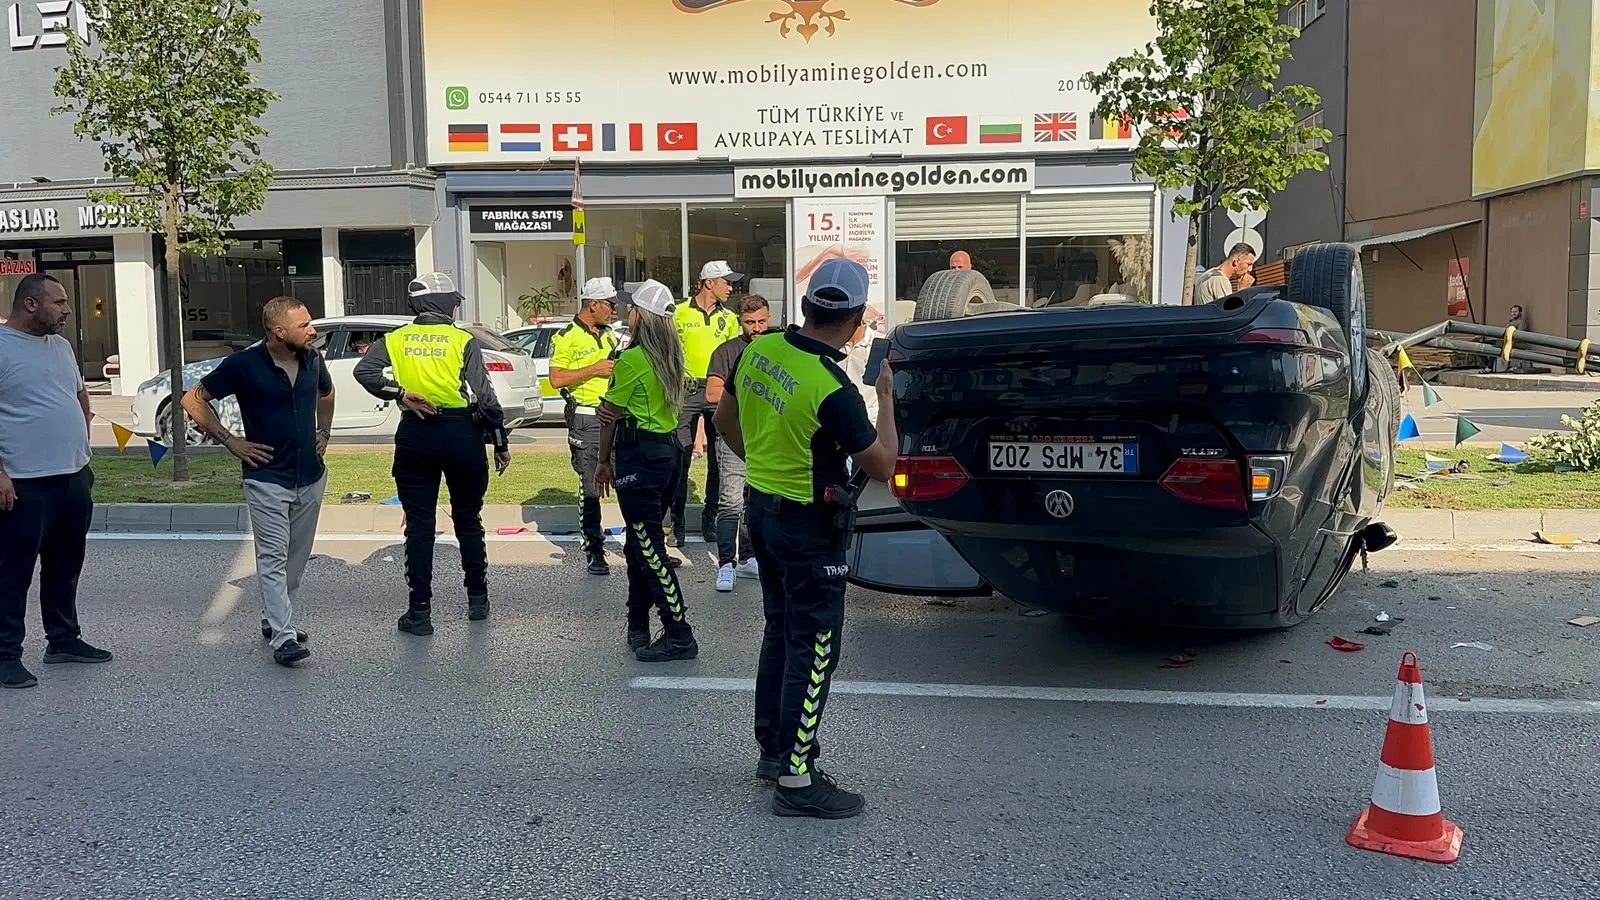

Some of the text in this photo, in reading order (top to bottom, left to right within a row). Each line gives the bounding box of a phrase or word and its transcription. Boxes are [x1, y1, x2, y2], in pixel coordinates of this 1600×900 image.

[668, 61, 988, 86] www.mobilyaminegolden.com
[479, 91, 581, 104] 0544 711 55 55
[757, 103, 904, 124] TÜM TÜRKİYE VE
[714, 126, 914, 148] AVRUPAYA TESLİMAT
[742, 165, 1028, 193] mobilyaminegolden.com
[482, 209, 564, 222] FABRİKA SATIŞ
[807, 213, 841, 231] 15.
[494, 219, 552, 232] MAĞAZASI
[808, 234, 840, 242] YILIMIZ
[992, 445, 1135, 470] TR 34 MPS 202
